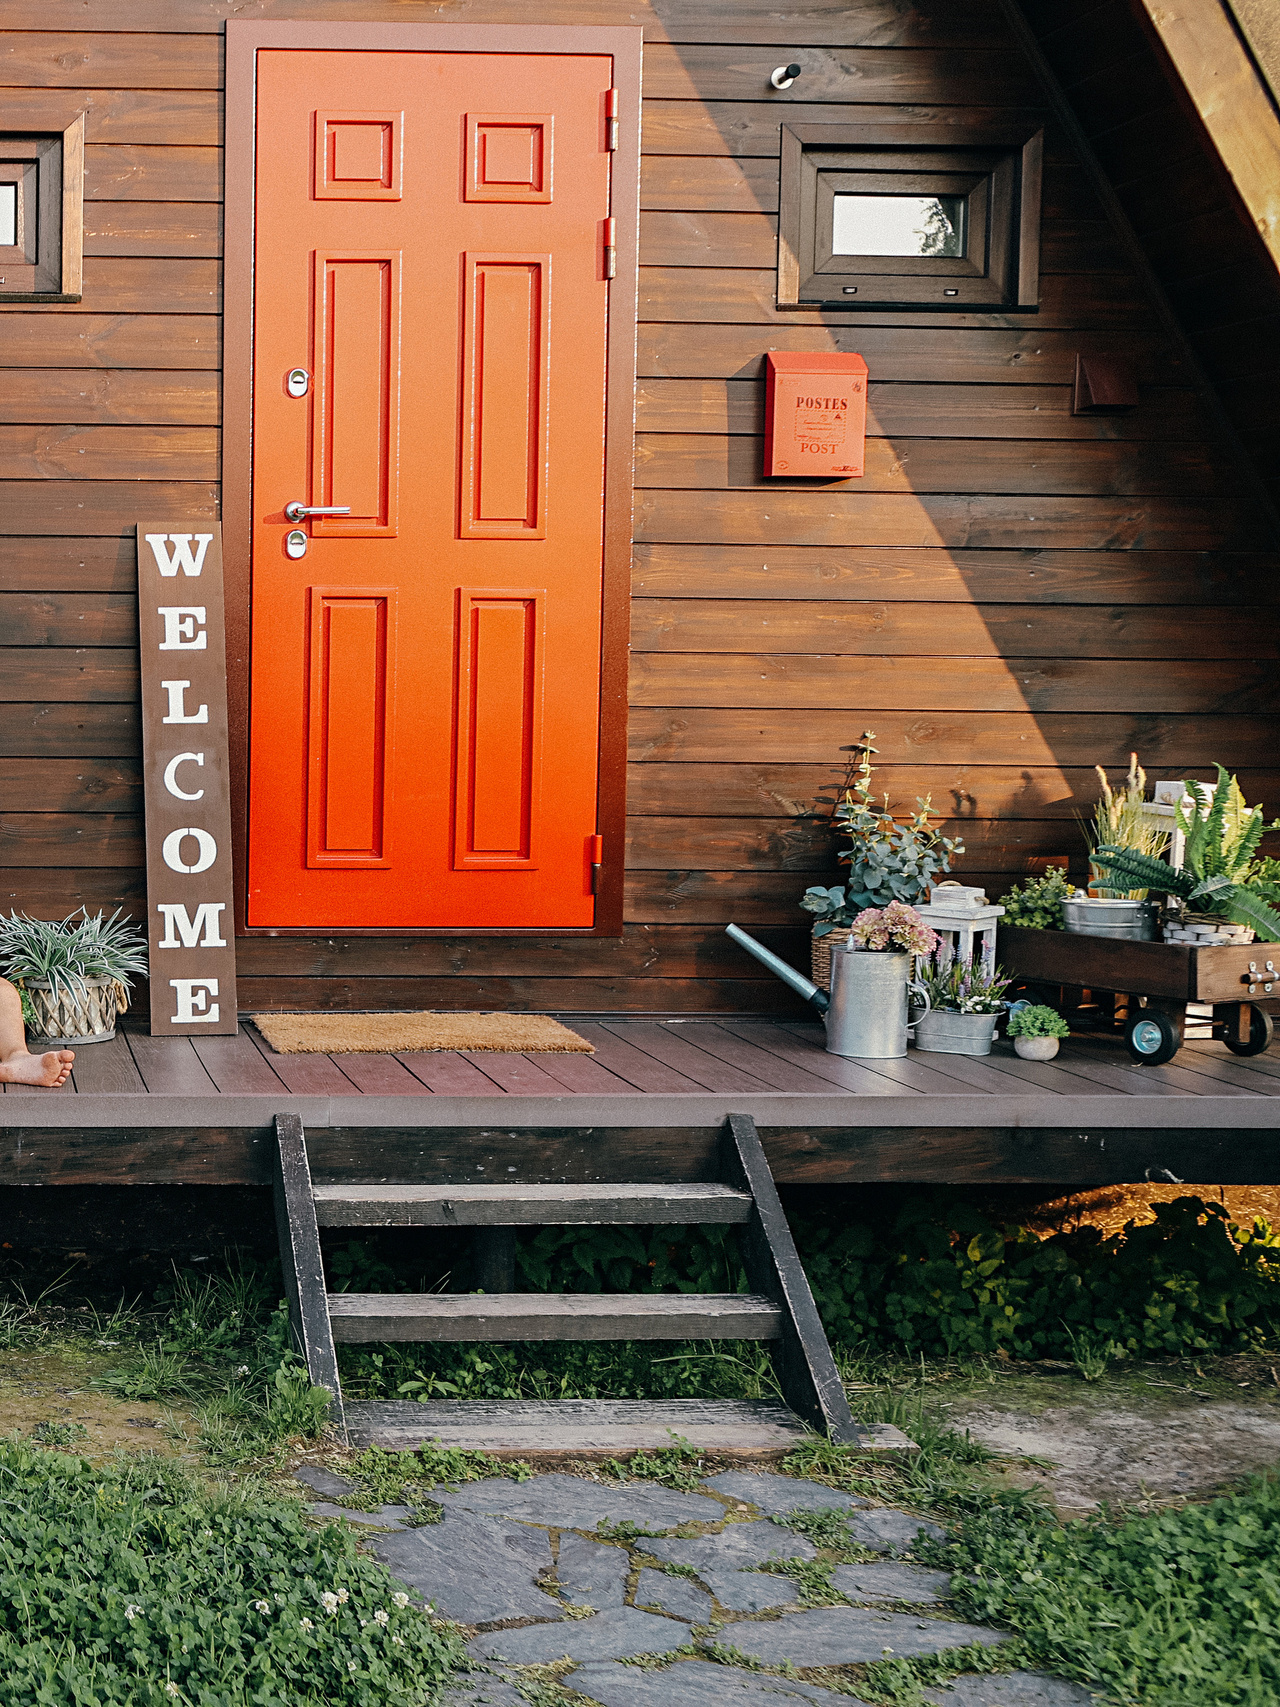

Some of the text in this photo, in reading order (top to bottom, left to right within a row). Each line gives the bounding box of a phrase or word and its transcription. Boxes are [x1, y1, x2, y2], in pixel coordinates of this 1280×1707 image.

[796, 396, 848, 410] POSTES
[800, 443, 839, 454] POST
[145, 533, 227, 1024] WELCOME
